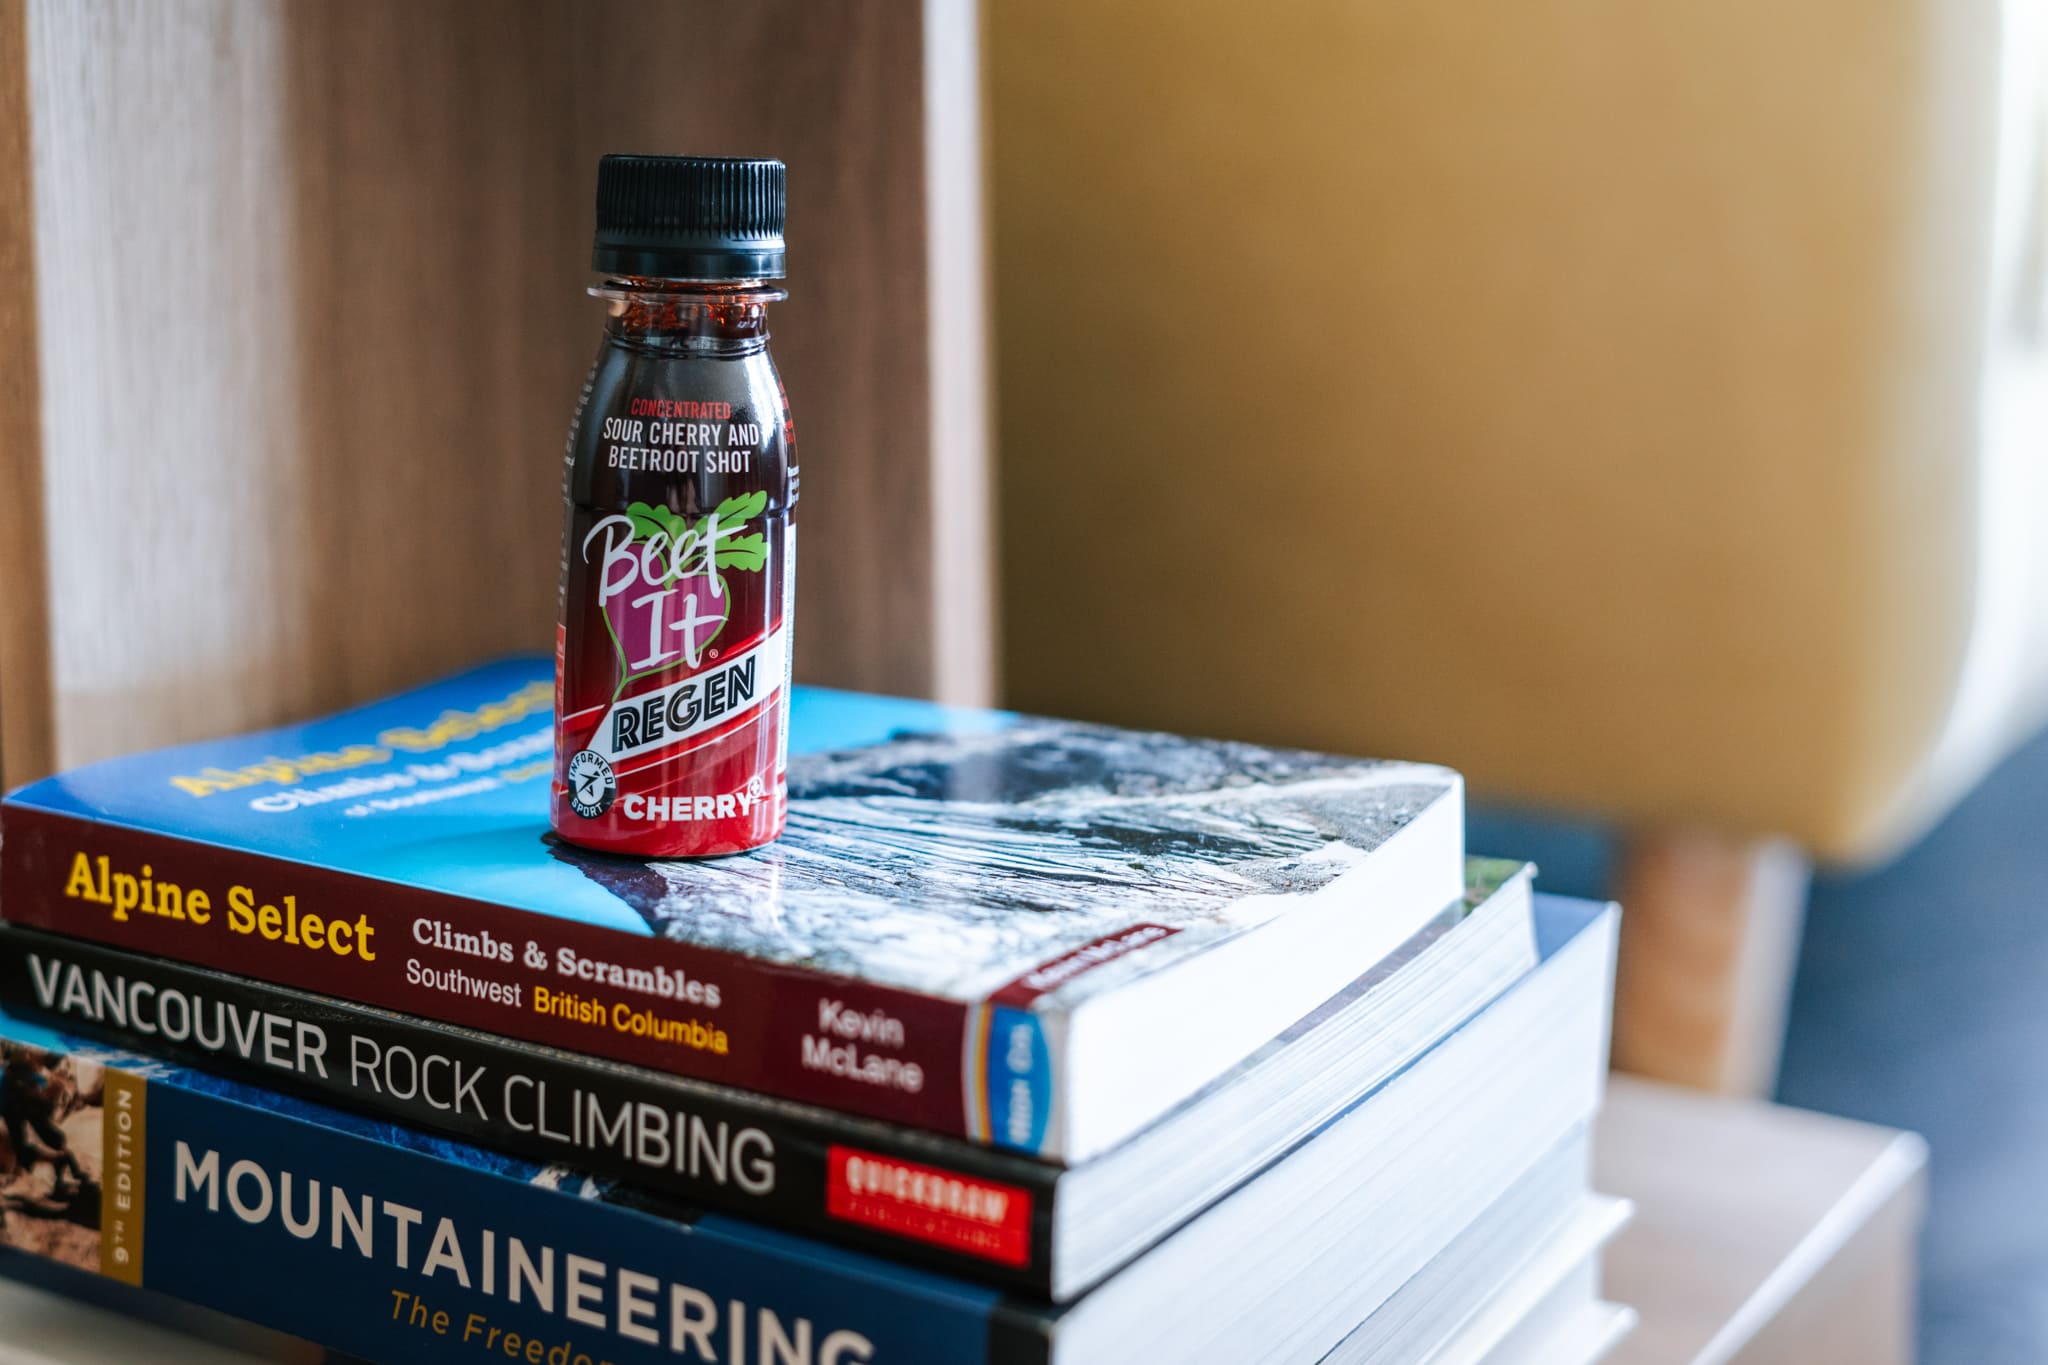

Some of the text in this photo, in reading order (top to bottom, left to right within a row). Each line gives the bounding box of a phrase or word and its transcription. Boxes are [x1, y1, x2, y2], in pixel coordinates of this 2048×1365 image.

[603, 417, 760, 446] SOUR CHERRY AND
[630, 398, 732, 420] CONCENTRATED
[608, 445, 751, 473] BEETROOT SHOT
[583, 513, 749, 607] Beet
[631, 588, 728, 669] It
[611, 655, 756, 753] REGEN
[569, 751, 614, 787] INFORMED
[571, 796, 603, 817] SPORT
[623, 792, 752, 822] CHERRY
[65, 851, 377, 962] Alpine Select
[412, 917, 723, 1009] Climbs & Scrambles
[405, 957, 730, 1056] Southwest British Columbia
[818, 996, 905, 1049] Kevin
[28, 953, 776, 1196] VANCOUVER ROCK CLIMBING
[801, 1033, 924, 1094] McLane
[116, 1088, 134, 1212] EDITION
[390, 1289, 612, 1365] The Freedo
